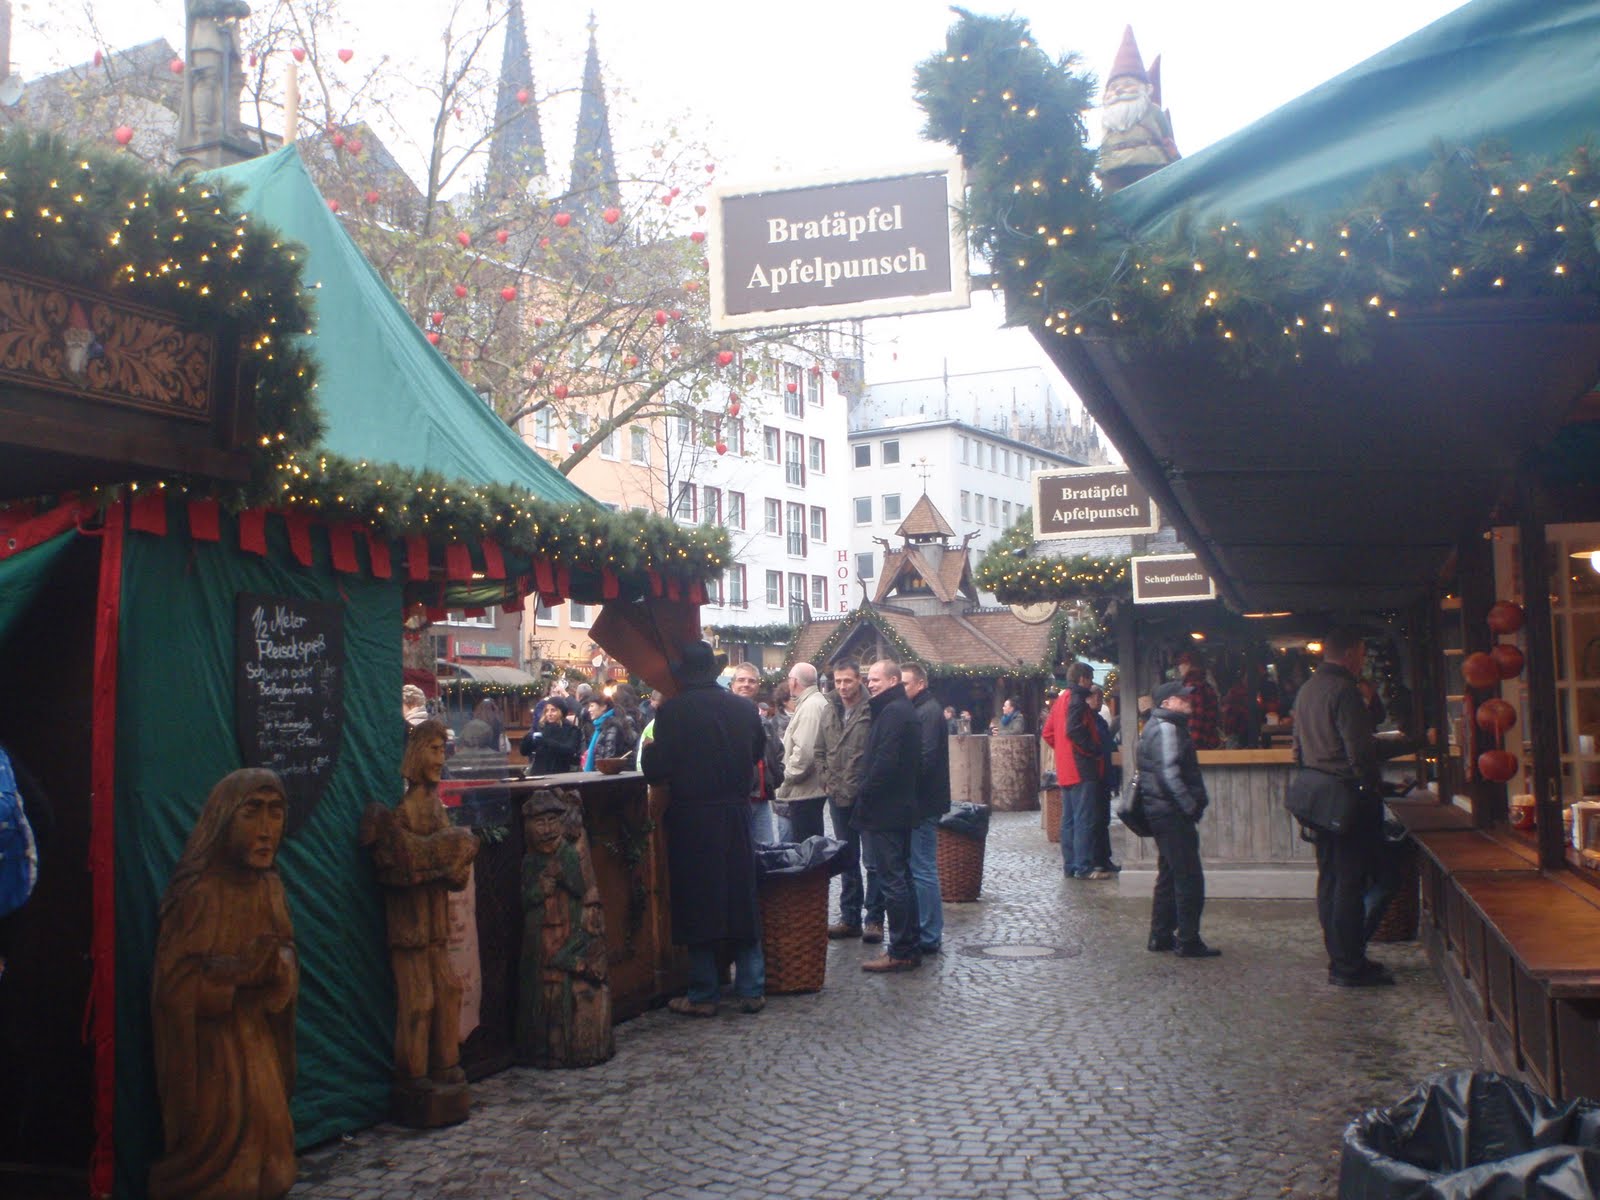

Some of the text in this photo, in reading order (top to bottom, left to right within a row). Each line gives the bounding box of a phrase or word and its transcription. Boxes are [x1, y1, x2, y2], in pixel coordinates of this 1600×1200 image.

[767, 205, 904, 244] Bratäpfel
[747, 246, 927, 294] Apfelpunsch
[1061, 484, 1128, 502] Bratäpfel
[1052, 504, 1140, 524] Apfelpunsch
[1144, 573, 1204, 585] Schupfnudeln
[271, 605, 307, 636] Meter
